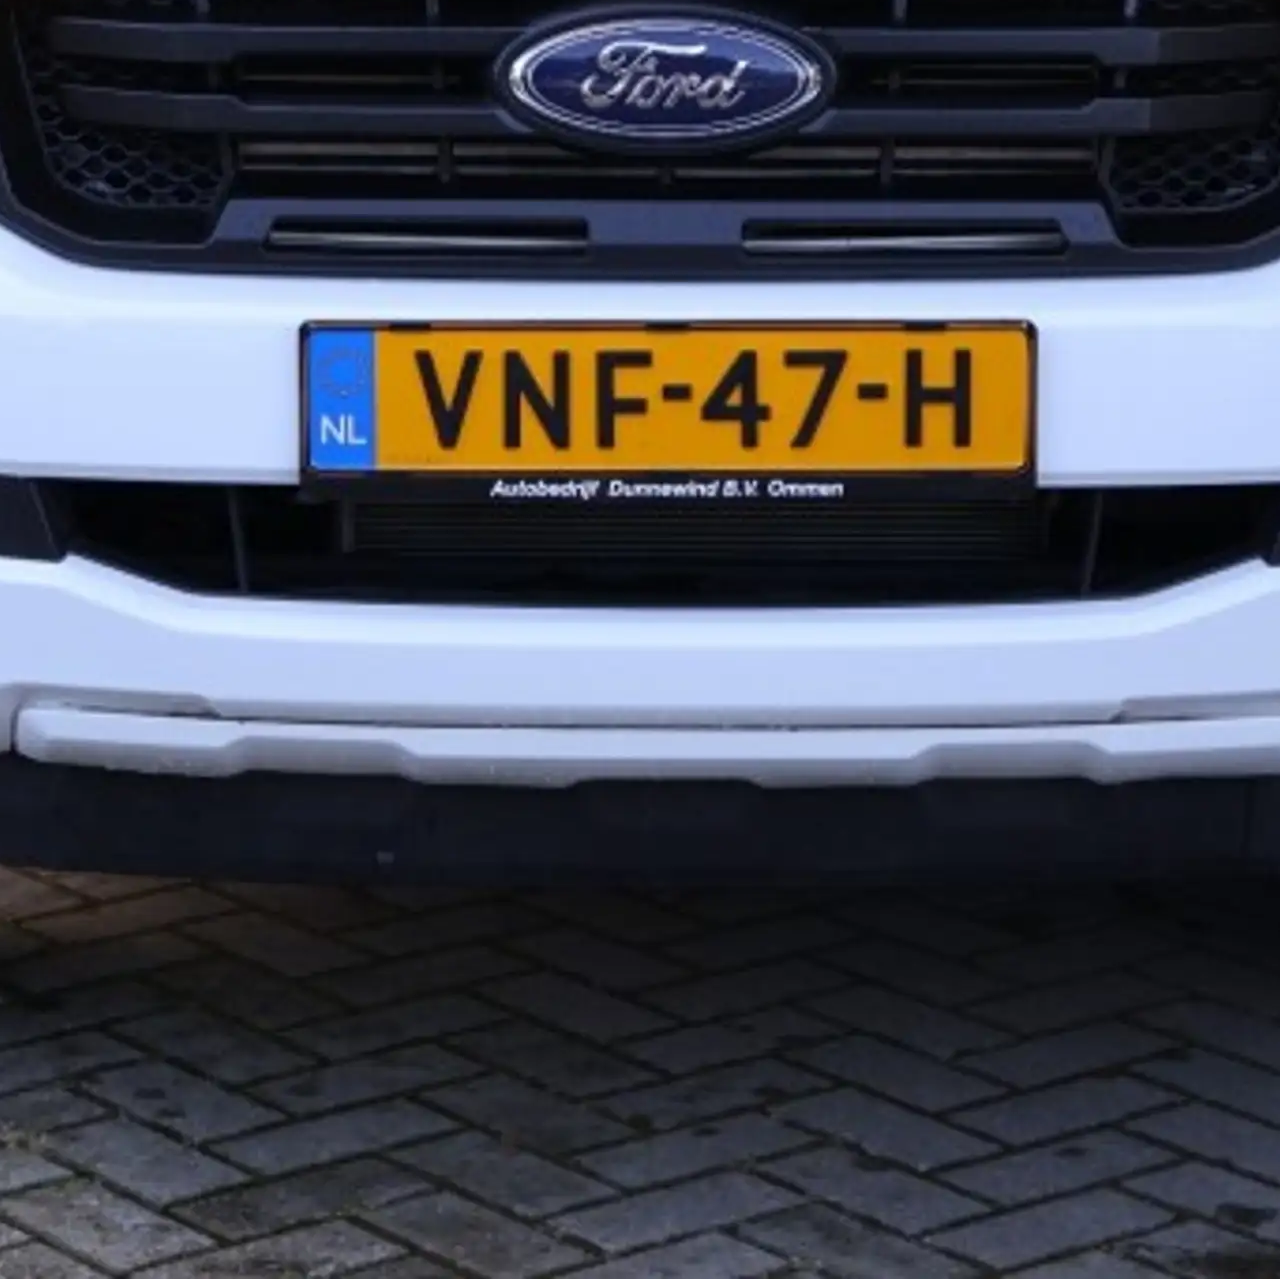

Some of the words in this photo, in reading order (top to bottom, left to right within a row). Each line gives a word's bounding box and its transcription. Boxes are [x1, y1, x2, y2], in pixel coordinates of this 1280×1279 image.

[580, 40, 749, 109] Ford
[414, 349, 973, 450] VNF-47-H
[320, 414, 368, 445] NL
[489, 479, 601, 501] Autobedrijf
[608, 479, 720, 498] Dunnewind
[767, 479, 845, 498] Ommen
